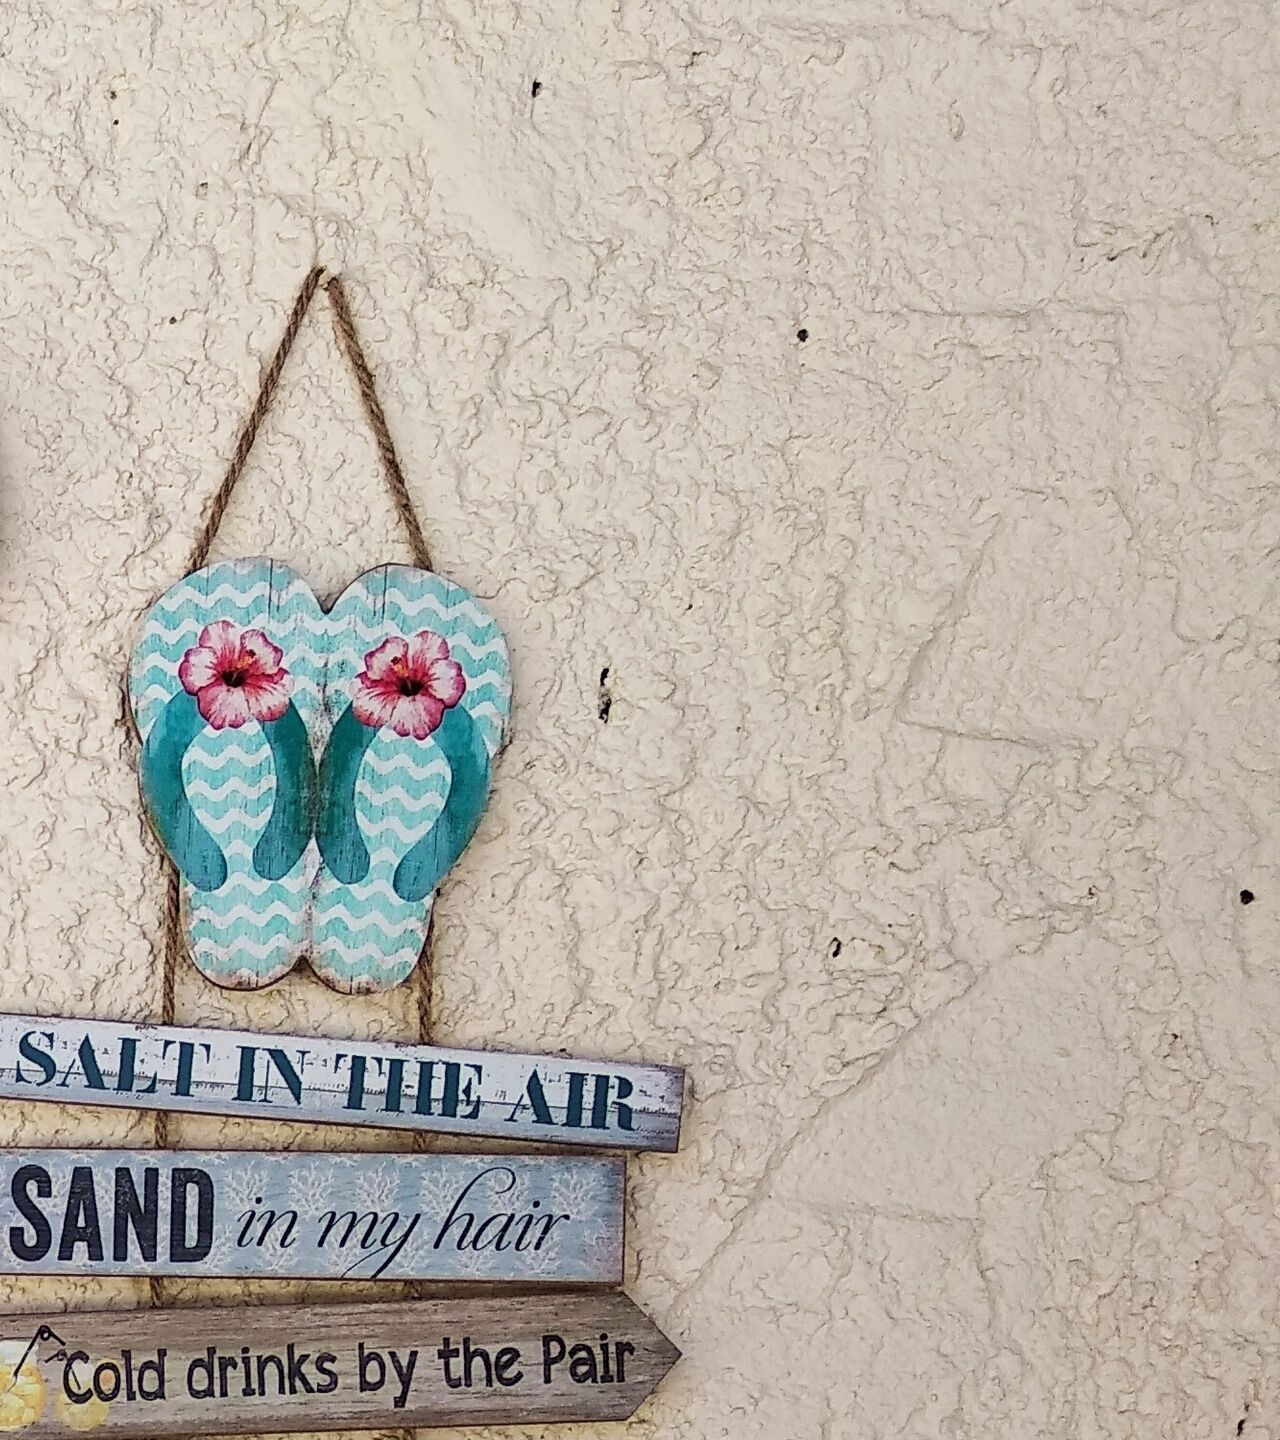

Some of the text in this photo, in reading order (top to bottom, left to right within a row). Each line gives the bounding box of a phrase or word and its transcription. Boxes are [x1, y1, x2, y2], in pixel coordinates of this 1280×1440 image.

[14, 1030, 641, 1133] SALT IN THE AIR
[9, 1163, 571, 1280] SAND in my hair
[61, 1332, 635, 1409] Cold drinks by the Pair
